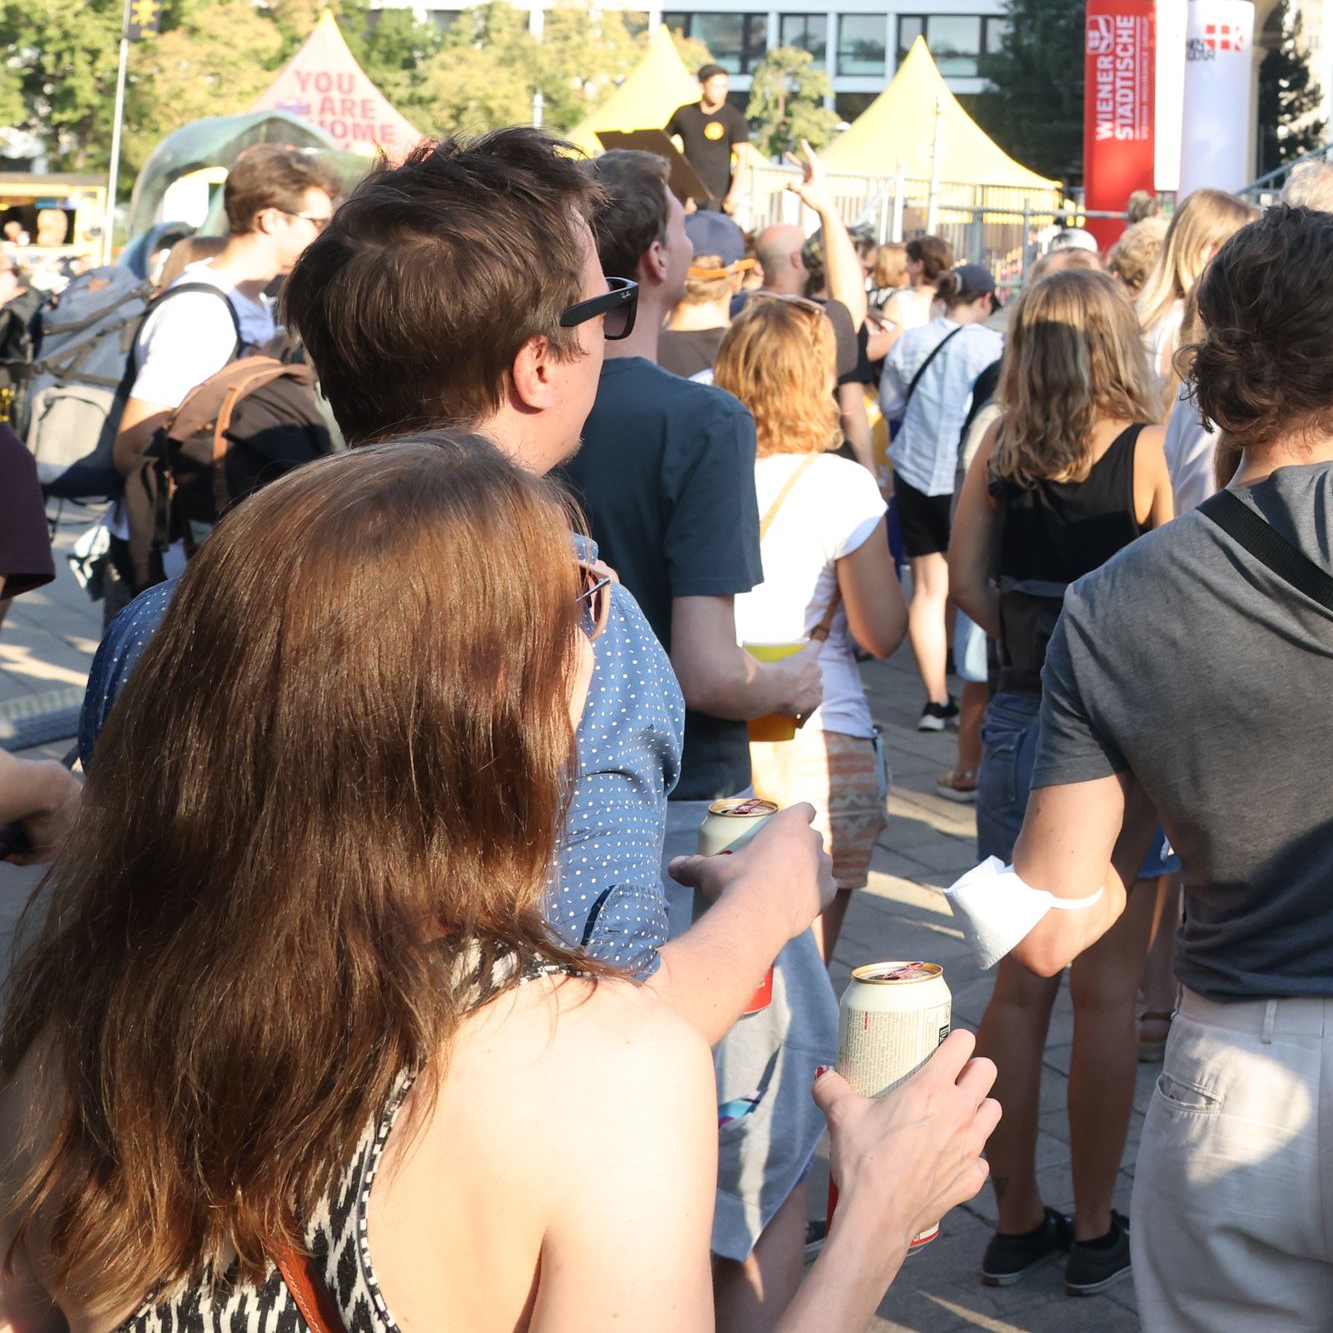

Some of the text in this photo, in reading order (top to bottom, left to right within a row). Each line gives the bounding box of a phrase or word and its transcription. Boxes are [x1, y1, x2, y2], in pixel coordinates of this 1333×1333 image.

[294, 70, 356, 94] YOU
[319, 97, 376, 120] ARE
[1096, 55, 1114, 141] WIENER
